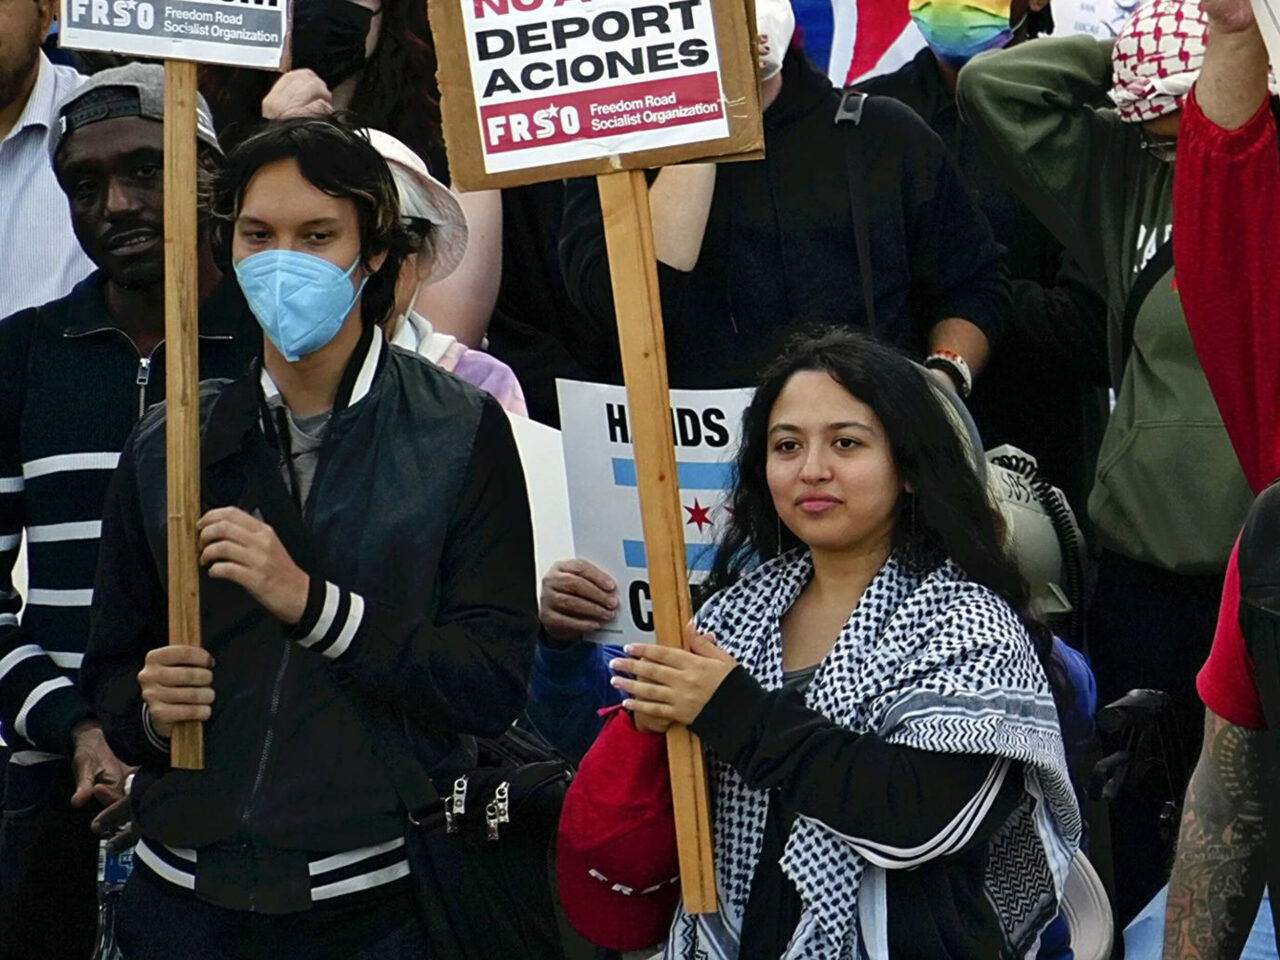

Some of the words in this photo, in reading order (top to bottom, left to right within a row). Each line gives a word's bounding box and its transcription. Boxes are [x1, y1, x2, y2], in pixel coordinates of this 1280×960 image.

[164, 6, 213, 22] Freedom
[215, 12, 243, 25] Road
[163, 20, 210, 36] Socialist
[210, 24, 279, 43] Organization
[482, 38, 710, 98] ACIONES
[590, 99, 643, 117] Freedom
[645, 92, 677, 108] Road
[591, 113, 642, 132] Socialist
[643, 101, 719, 127] Organization
[606, 403, 730, 448] HDS
